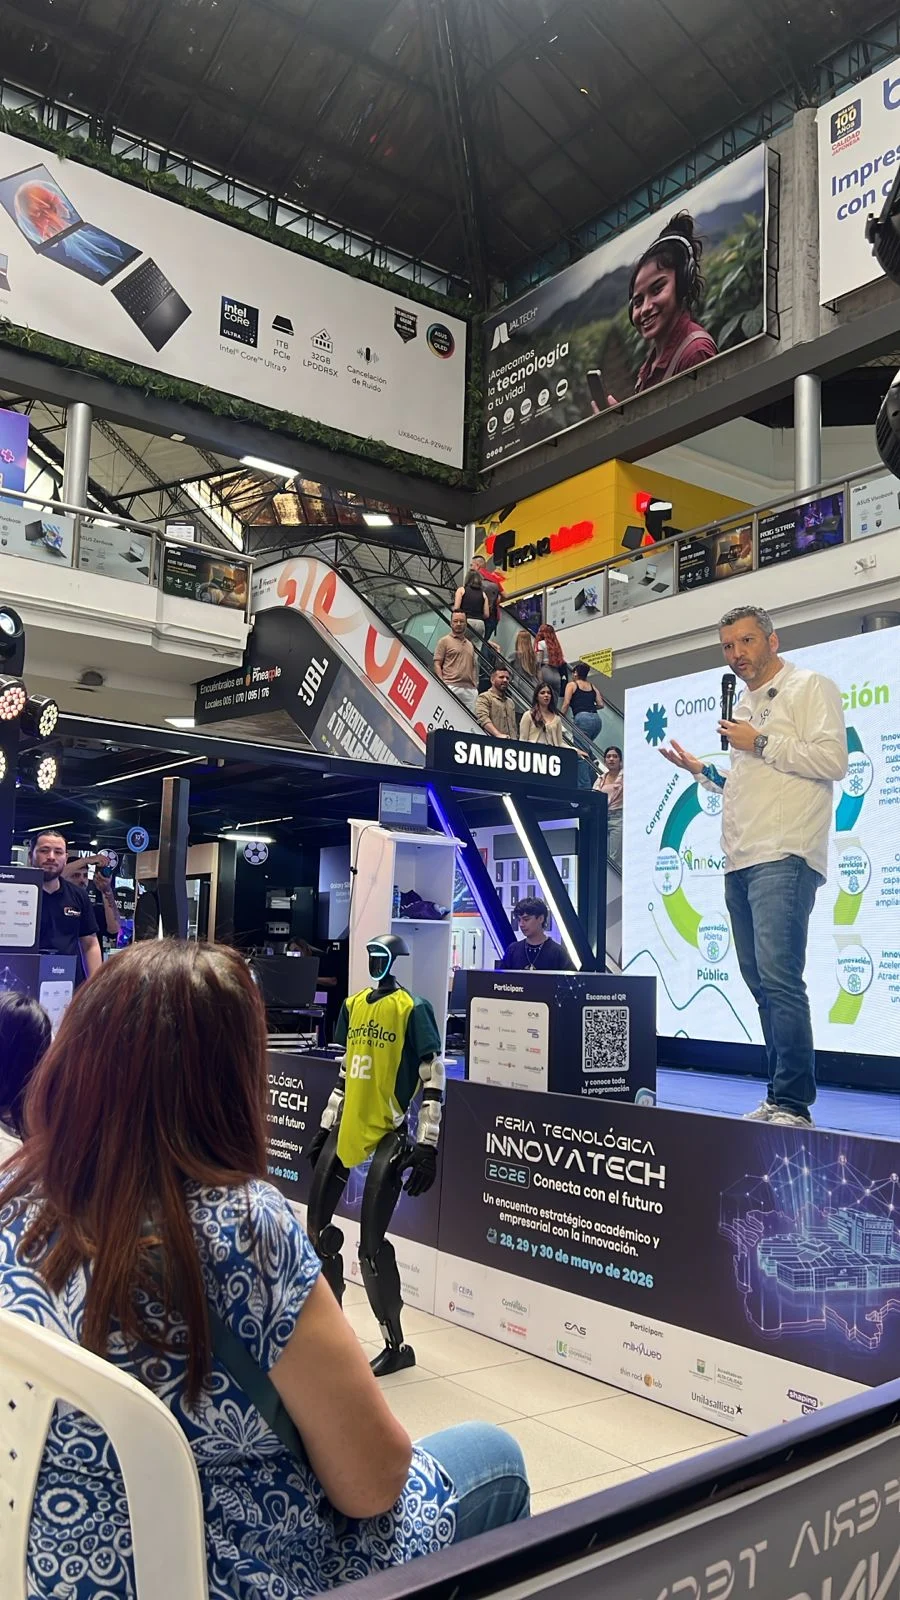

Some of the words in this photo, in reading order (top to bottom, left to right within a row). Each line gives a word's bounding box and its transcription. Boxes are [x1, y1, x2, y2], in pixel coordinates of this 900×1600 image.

[835, 108, 856, 129] 100
[832, 131, 860, 150] CALIDAD
[836, 188, 876, 220] con
[224, 301, 247, 318] intel
[223, 329, 241, 339] ULTRA
[434, 331, 448, 340] ASUS
[276, 339, 289, 349] 1TB
[274, 349, 291, 360] PCIe
[311, 352, 331, 365] 32GB
[264, 360, 281, 371] Ultra
[302, 359, 338, 377] LPDDR5X
[488, 349, 535, 383] ¡Acercamos
[346, 365, 387, 385] Cancelación
[352, 377, 361, 386] de
[362, 380, 382, 392] Ruido
[488, 386, 496, 396] la
[488, 402, 493, 410] a
[495, 397, 504, 406] tu
[505, 382, 526, 401] vida!
[760, 528, 774, 538] ROG
[774, 522, 795, 533] STRIX
[252, 666, 281, 682] Pineapple
[298, 657, 329, 706] JBL
[200, 679, 235, 694] Encuéntralos
[236, 678, 243, 686] en
[397, 672, 417, 706] JBL
[205, 699, 222, 709] Locales
[223, 695, 232, 706] 005
[236, 693, 244, 703] 070
[248, 690, 257, 700] 095
[261, 687, 270, 697] 176
[840, 682, 889, 710] ción
[675, 696, 716, 717] Como
[327, 712, 337, 731] A
[333, 717, 346, 740] TU
[361, 726, 374, 748] EL
[454, 741, 561, 777] SAMSUNG
[645, 773, 679, 835] Corporativa
[699, 924, 728, 933] Innovación
[704, 933, 722, 941] Abierta
[838, 958, 870, 966] Innovación
[697, 967, 729, 981] Pública
[494, 983, 524, 993] Participan:
[350, 1054, 372, 1079] 82
[267, 1072, 304, 1090] OLÓGICA
[588, 1085, 630, 1095] programación
[270, 1089, 308, 1113] TECH
[266, 1114, 278, 1124] con
[278, 1115, 284, 1126] el
[285, 1116, 305, 1130] futuro
[496, 1116, 535, 1134] FERIA
[542, 1123, 655, 1156] TECNOLÓGICA
[271, 1138, 298, 1151] académico
[298, 1145, 303, 1154] y
[486, 1132, 666, 1189] INNOVATECH
[275, 1166, 282, 1176] de
[283, 1168, 298, 1181] 2026
[489, 1164, 526, 1184] 2026
[533, 1173, 581, 1196] Conecta
[584, 1186, 605, 1202] con
[608, 1190, 619, 1205] el
[622, 1191, 663, 1215] futuro
[483, 1192, 494, 1205] Un
[495, 1197, 538, 1216] encuentro
[539, 1207, 592, 1230] estratégico
[594, 1220, 650, 1245] académico
[653, 1236, 660, 1248] y
[499, 1211, 550, 1233] empresarial
[552, 1224, 570, 1237] con
[571, 1228, 580, 1241] la
[582, 1231, 639, 1257] innovación.
[500, 1233, 514, 1250] 28,
[516, 1237, 529, 1252] 29
[531, 1244, 538, 1257] y
[539, 1244, 553, 1259] 30
[555, 1249, 569, 1264] de
[570, 1255, 603, 1274] mayo
[605, 1262, 620, 1279] de
[622, 1268, 654, 1289] 2026
[458, 1286, 473, 1296] CEIPA
[630, 1321, 664, 1338] Participan:
[620, 1367, 630, 1377] thin
[632, 1373, 642, 1381] rock
[691, 1392, 734, 1415] Unilasallista
[790, 1391, 816, 1407] shaping
